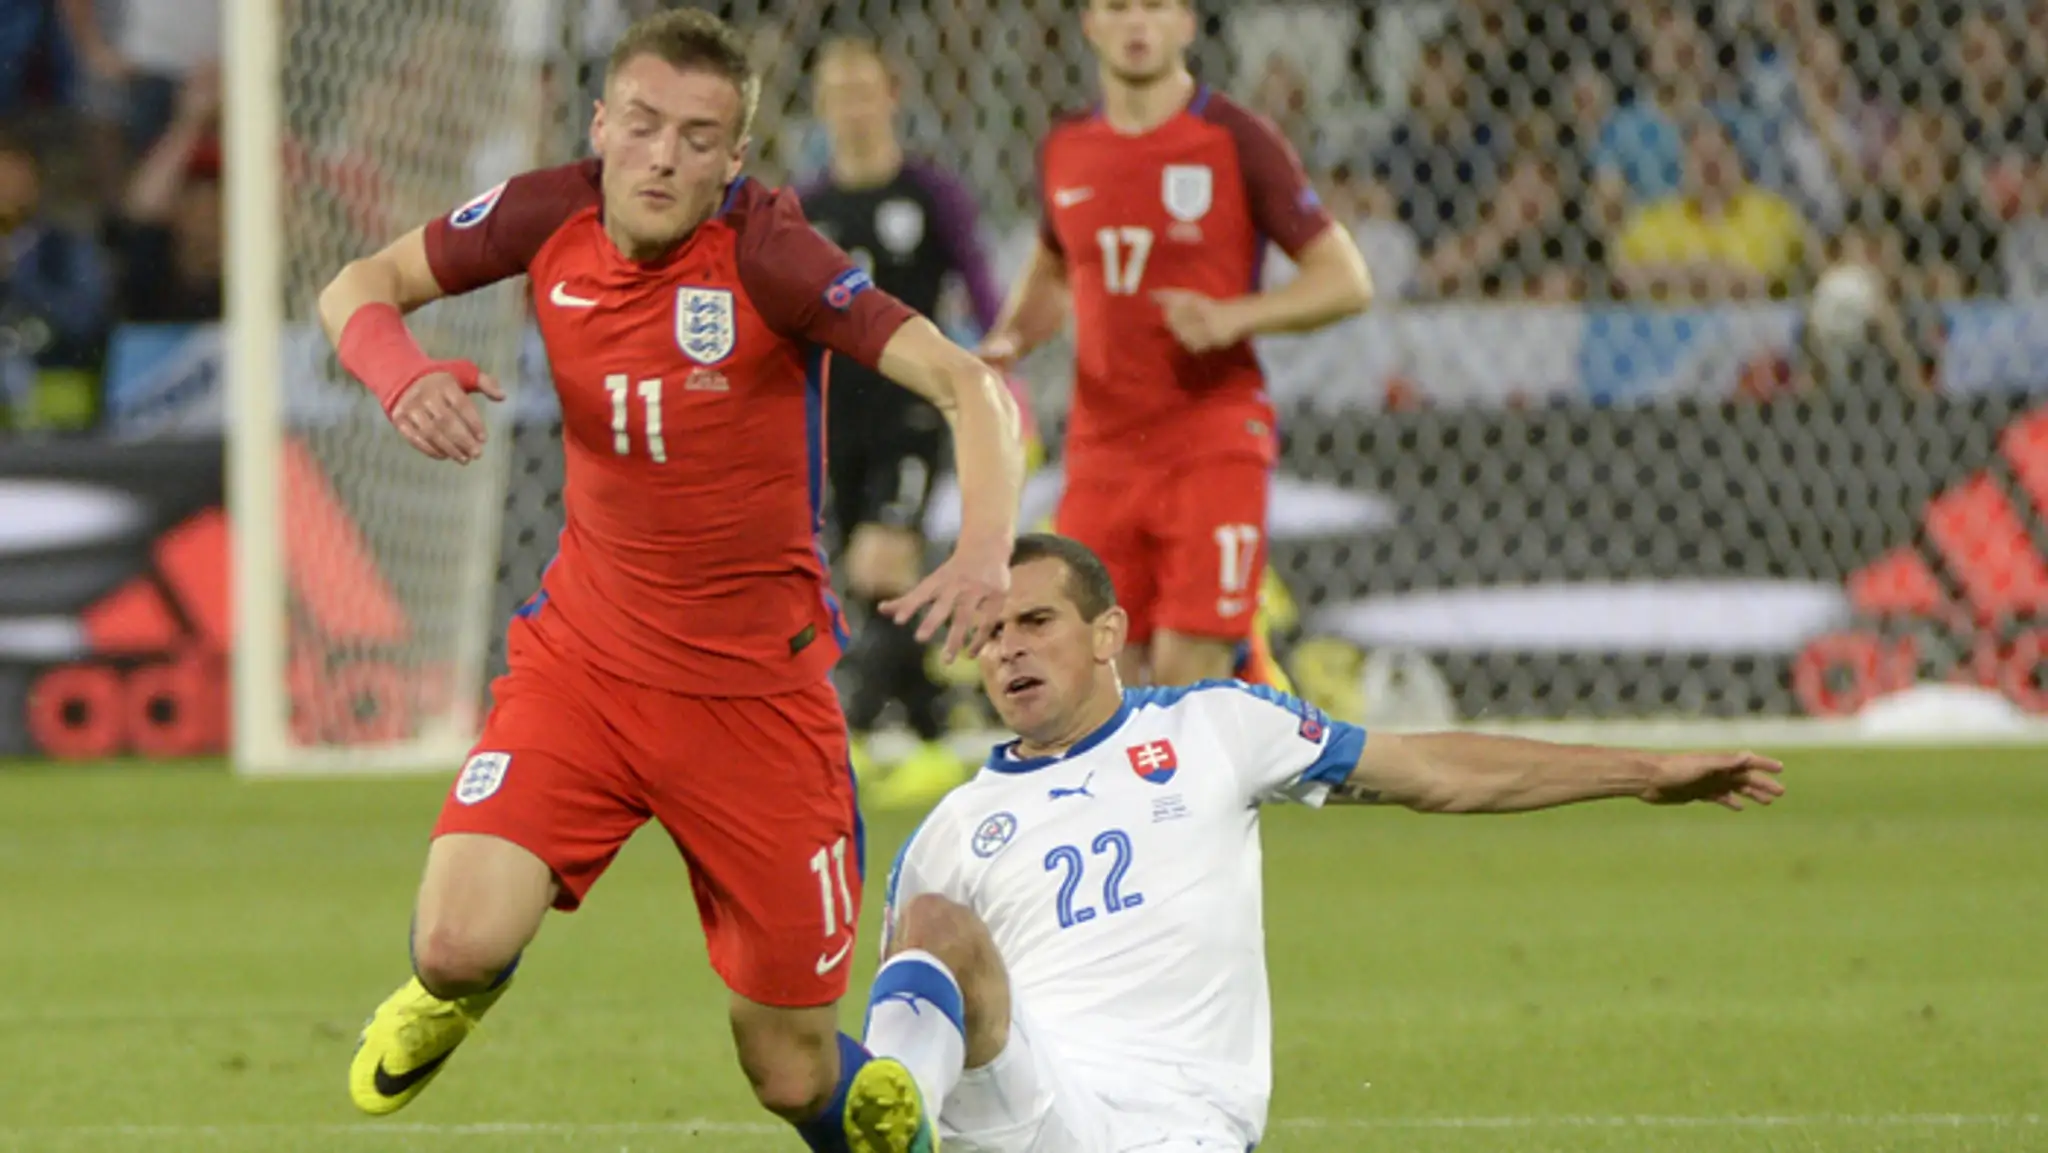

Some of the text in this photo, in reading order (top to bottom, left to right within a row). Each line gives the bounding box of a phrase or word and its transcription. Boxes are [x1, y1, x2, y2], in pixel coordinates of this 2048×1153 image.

[1097, 226, 1153, 295] 17
[605, 373, 667, 463] 11
[1214, 524, 1259, 593] 17
[810, 836, 853, 938] 11
[1044, 829, 1144, 929] 22
